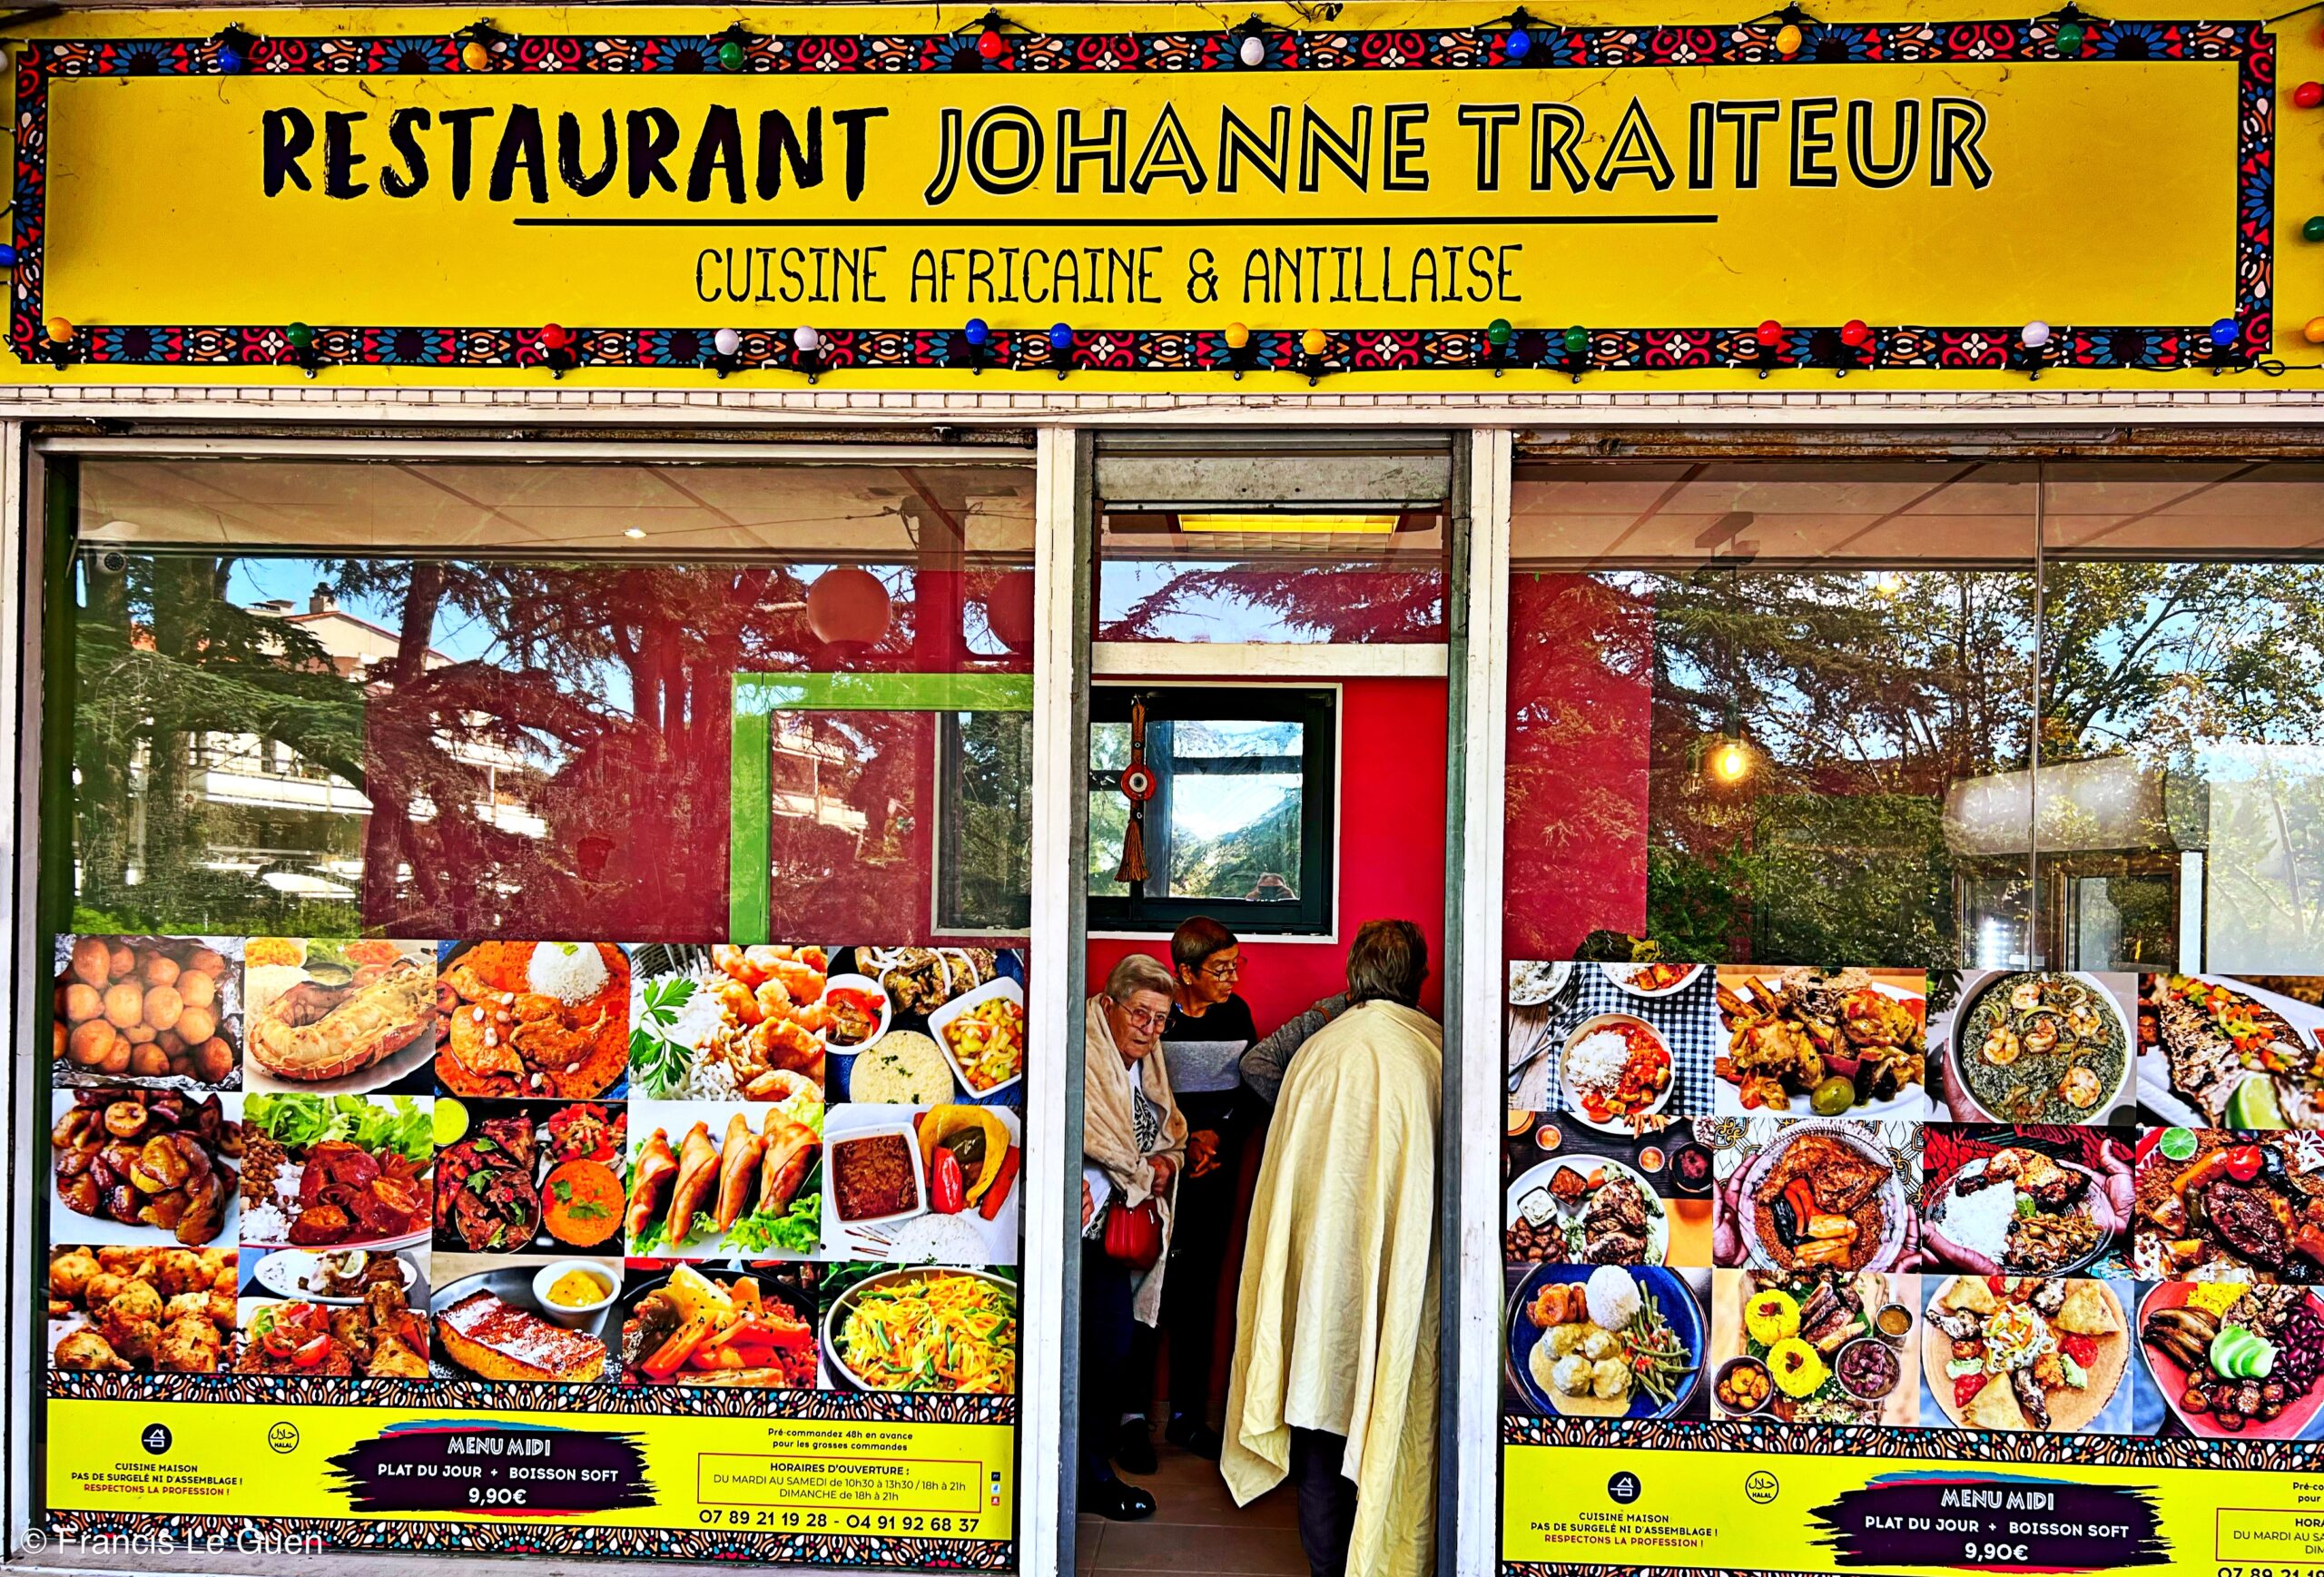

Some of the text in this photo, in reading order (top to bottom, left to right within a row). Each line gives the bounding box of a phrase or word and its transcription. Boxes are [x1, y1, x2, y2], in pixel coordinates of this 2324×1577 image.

[261, 95, 1994, 207] RESTAURANT JOHANNE TRAITEUR
[695, 243, 1523, 304] CUISINE AFRICAINE & ANTILLAISE
[272, 1428, 296, 1440] حلال
[769, 1428, 842, 1437] Pré-commandez
[448, 1436, 550, 1456] MENU MIDI
[797, 1440, 809, 1448] les
[159, 1464, 197, 1473] MAISON
[379, 1464, 413, 1475] PLAT
[418, 1465, 437, 1476] DU
[443, 1465, 481, 1477] JOUR
[510, 1467, 576, 1480] BOISSON
[582, 1470, 618, 1482] SOFT
[771, 1463, 824, 1473] HORAIRES
[107, 1474, 149, 1482] SURGELÉ
[714, 1474, 729, 1483] DU
[733, 1475, 766, 1483] MARDI
[769, 1476, 783, 1484] AU
[787, 1477, 826, 1486] SAMEDI
[845, 1479, 874, 1488] 10h30
[877, 1480, 882, 1488] à
[885, 1480, 913, 1489] 13h30
[922, 1482, 938, 1490] 18h
[941, 1482, 947, 1490] à
[950, 1482, 965, 1491] 21h
[1748, 1477, 1775, 1489] حلال
[84, 1483, 144, 1493] RESPECTONS
[162, 1486, 223, 1495] PROFESSION
[780, 1489, 898, 1501] DIMANCHE de 18h à 21h
[469, 1488, 526, 1505] 9,90€
[1941, 1489, 2053, 1510] MENU MIDI
[699, 1510, 722, 1523] 07
[729, 1511, 749, 1524] 89
[757, 1512, 773, 1525] 21
[782, 1513, 799, 1526] 19
[806, 1513, 826, 1527] 28
[847, 1514, 871, 1528] 04
[878, 1516, 894, 1529] 91
[902, 1517, 923, 1531] 92
[931, 1517, 951, 1532] 68
[959, 1519, 979, 1533] 37
[1580, 1513, 1669, 1523] CUISINE MAISON
[1531, 1523, 1550, 1531] PAS
[1571, 1523, 1616, 1533] SURGELÉ
[1620, 1525, 1630, 1533] NI
[1866, 1516, 1903, 1529] PLAT
[1909, 1518, 1930, 1530] DU
[1935, 1519, 1978, 1532] JOUR
[2010, 1522, 2083, 1537] BOISSON
[2088, 1524, 2129, 1538] SOFT
[1545, 1534, 1610, 1543] RESPECTONS
[1631, 1537, 1697, 1547] PROFESSION
[2234, 1531, 2250, 1539] DU
[2254, 1532, 2290, 1540] MARDI
[2294, 1533, 2309, 1541] AU
[1965, 1543, 2028, 1562] 9,90€
